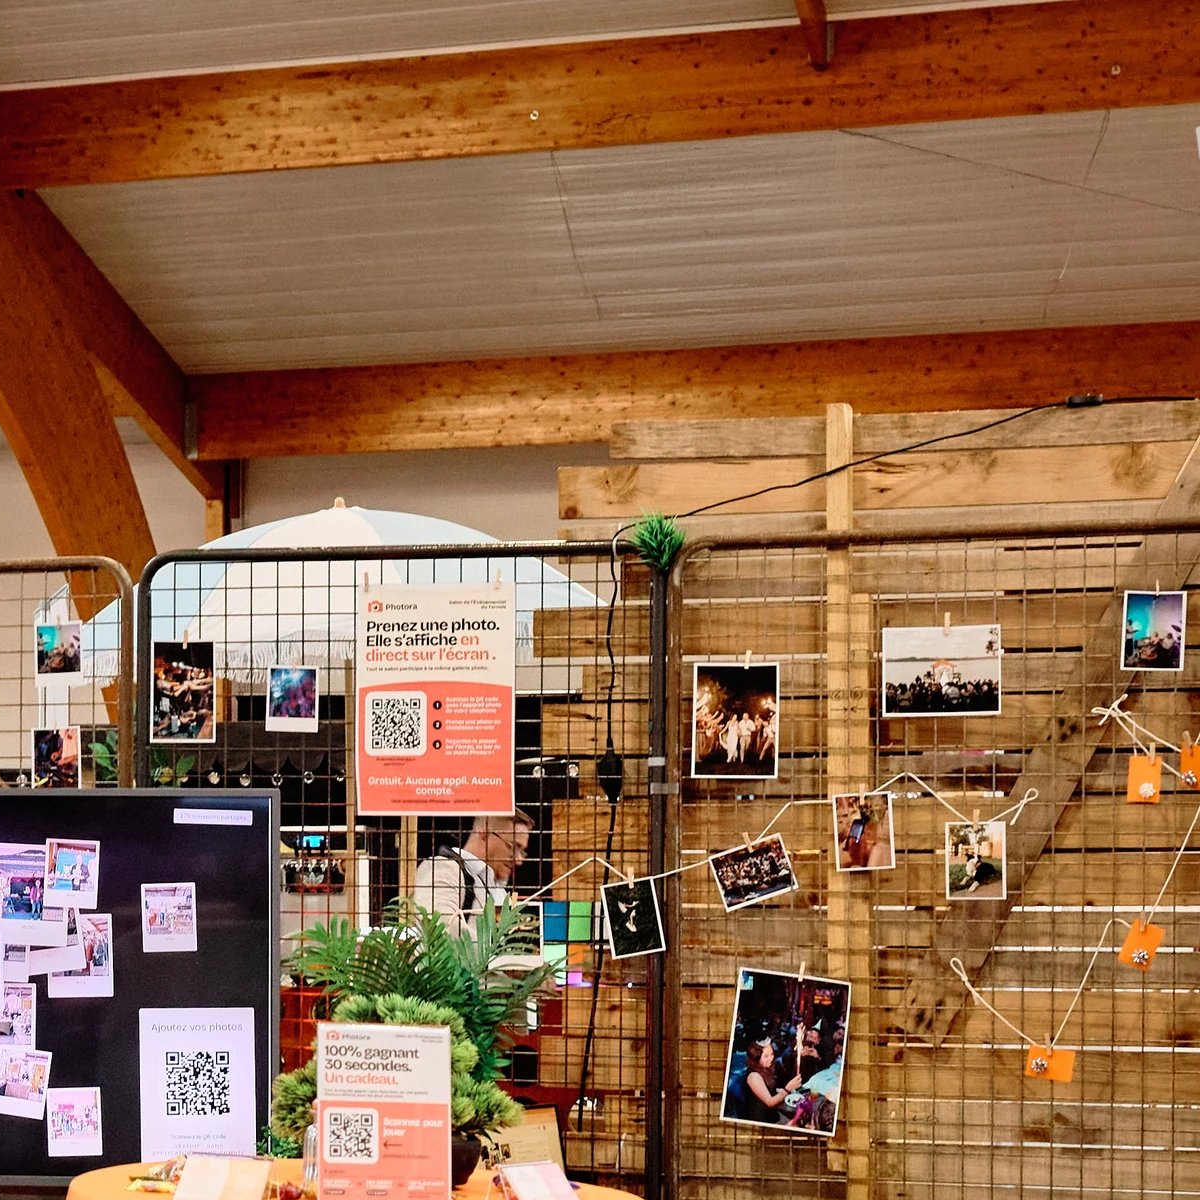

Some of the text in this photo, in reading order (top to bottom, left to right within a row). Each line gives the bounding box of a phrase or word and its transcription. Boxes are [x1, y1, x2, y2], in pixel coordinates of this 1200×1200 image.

[386, 603, 417, 611] Photora
[367, 619, 500, 634] Prenez une photo.
[366, 633, 479, 647] Elle s'affiche en
[366, 648, 410, 661] direct
[412, 649, 434, 661] sur
[368, 776, 502, 787] Gratuit. Aucune appli. Aucun
[151, 1023, 186, 1033] Ajoutez
[210, 1023, 243, 1032] photos
[325, 1046, 419, 1060] 100% gagnant
[325, 1059, 412, 1072] 30 secondes.
[325, 1073, 398, 1085] Un cadeau.
